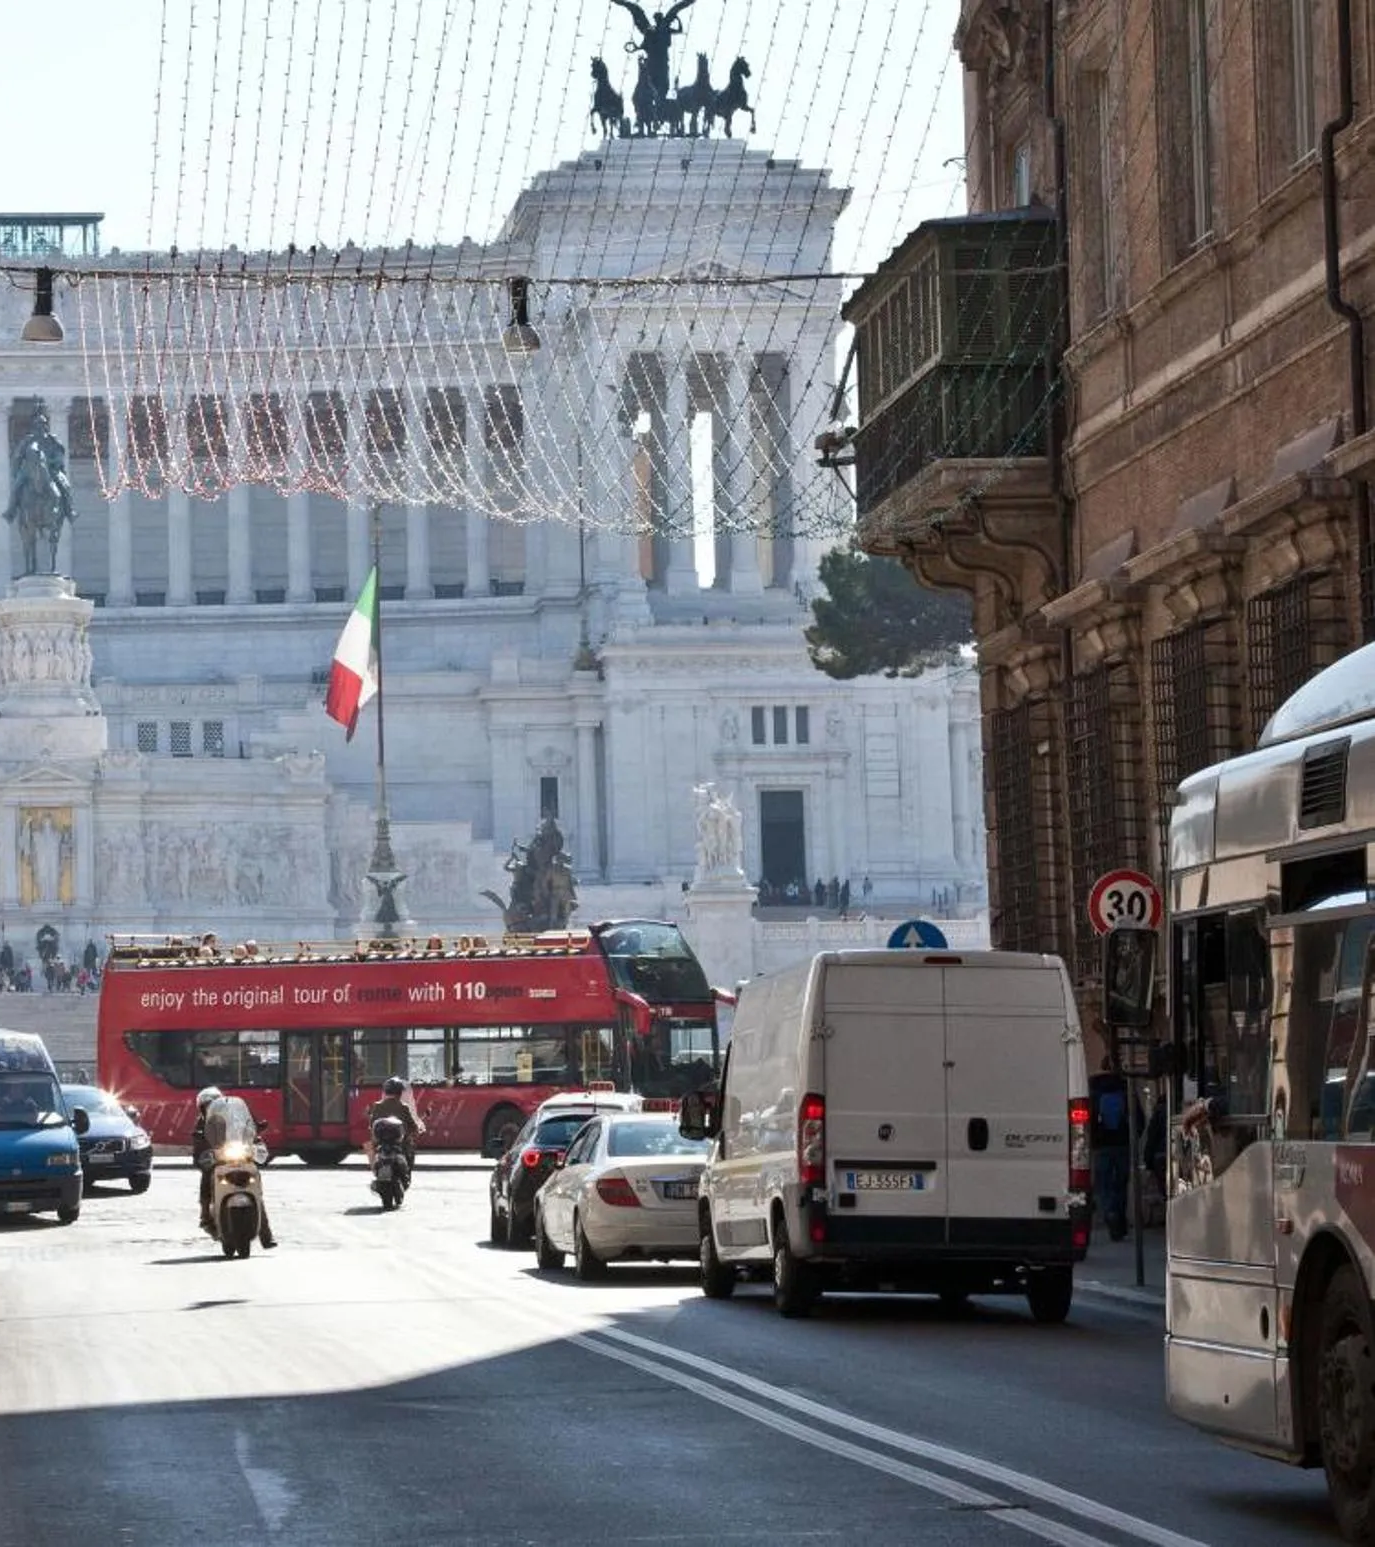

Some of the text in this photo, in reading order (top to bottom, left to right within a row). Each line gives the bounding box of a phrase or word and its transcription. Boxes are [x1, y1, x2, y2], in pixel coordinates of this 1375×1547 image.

[1107, 890, 1147, 922] 30
[141, 989, 184, 1010] enjoy
[192, 988, 218, 1006] the
[223, 985, 283, 1009] original
[294, 986, 328, 1004] tour
[333, 984, 351, 1004] of
[408, 982, 445, 1001] with
